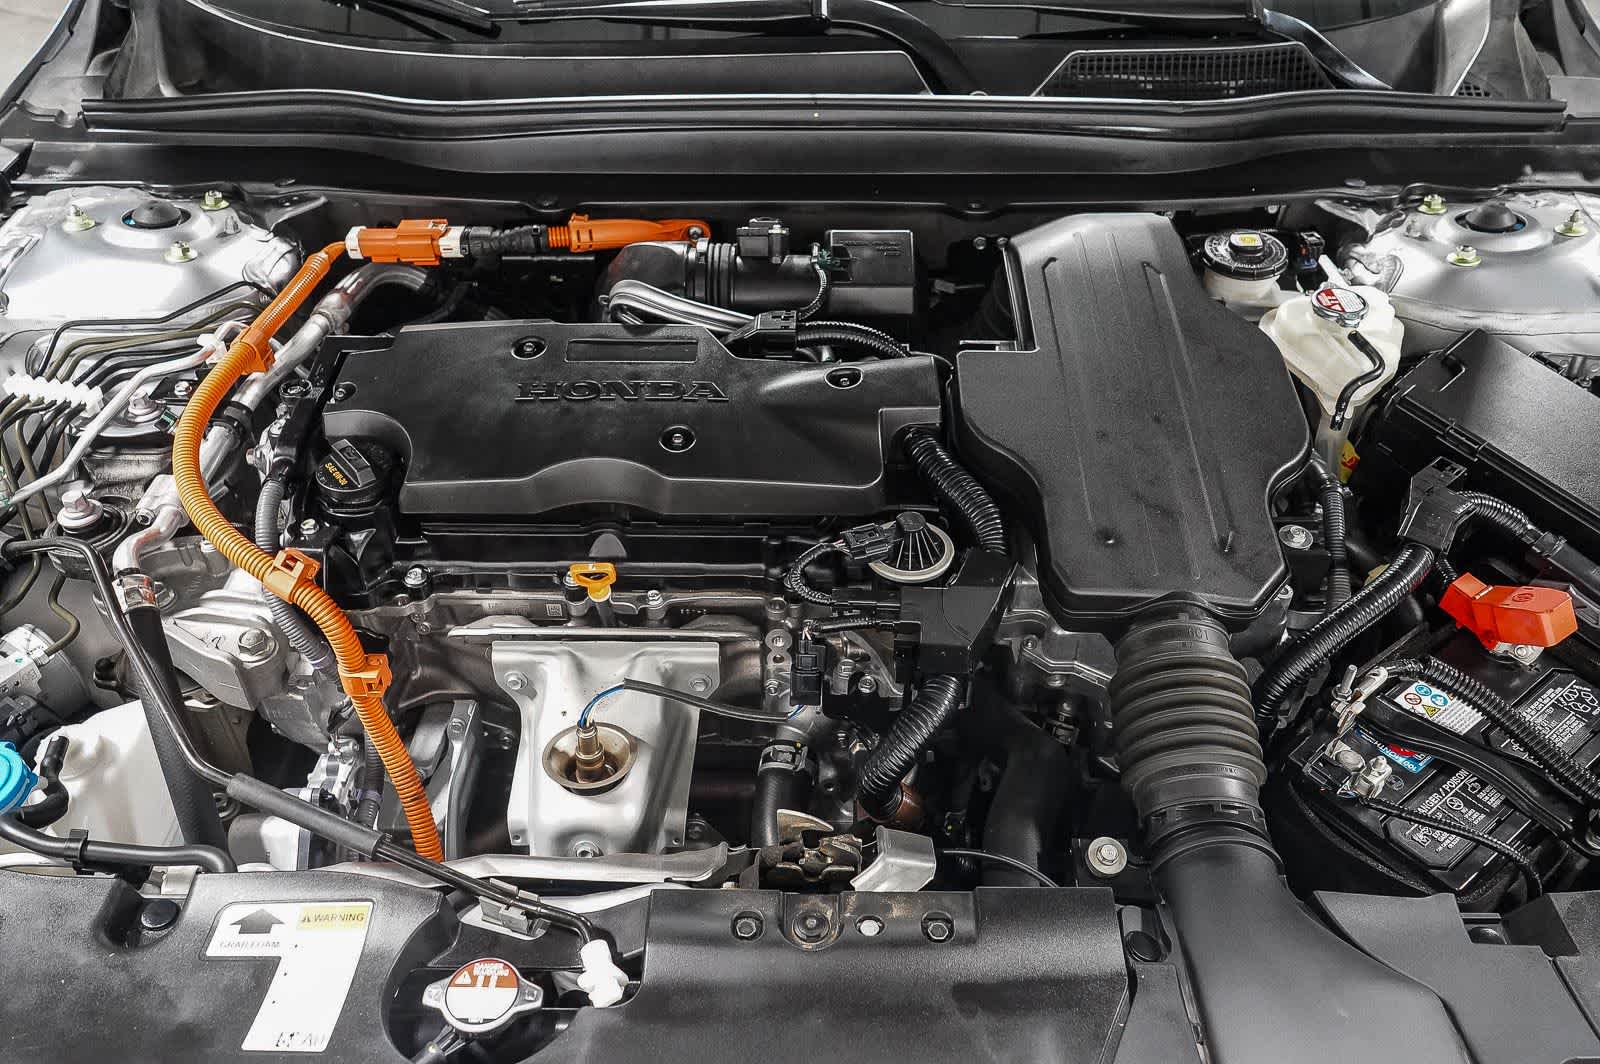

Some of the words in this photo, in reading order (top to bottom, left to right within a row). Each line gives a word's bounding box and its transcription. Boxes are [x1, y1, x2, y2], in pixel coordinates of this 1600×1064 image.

[515, 379, 730, 402] HONDA
[1416, 792, 1443, 816] ANGER
[1441, 768, 1470, 793] POISON
[313, 912, 365, 922] WARNING
